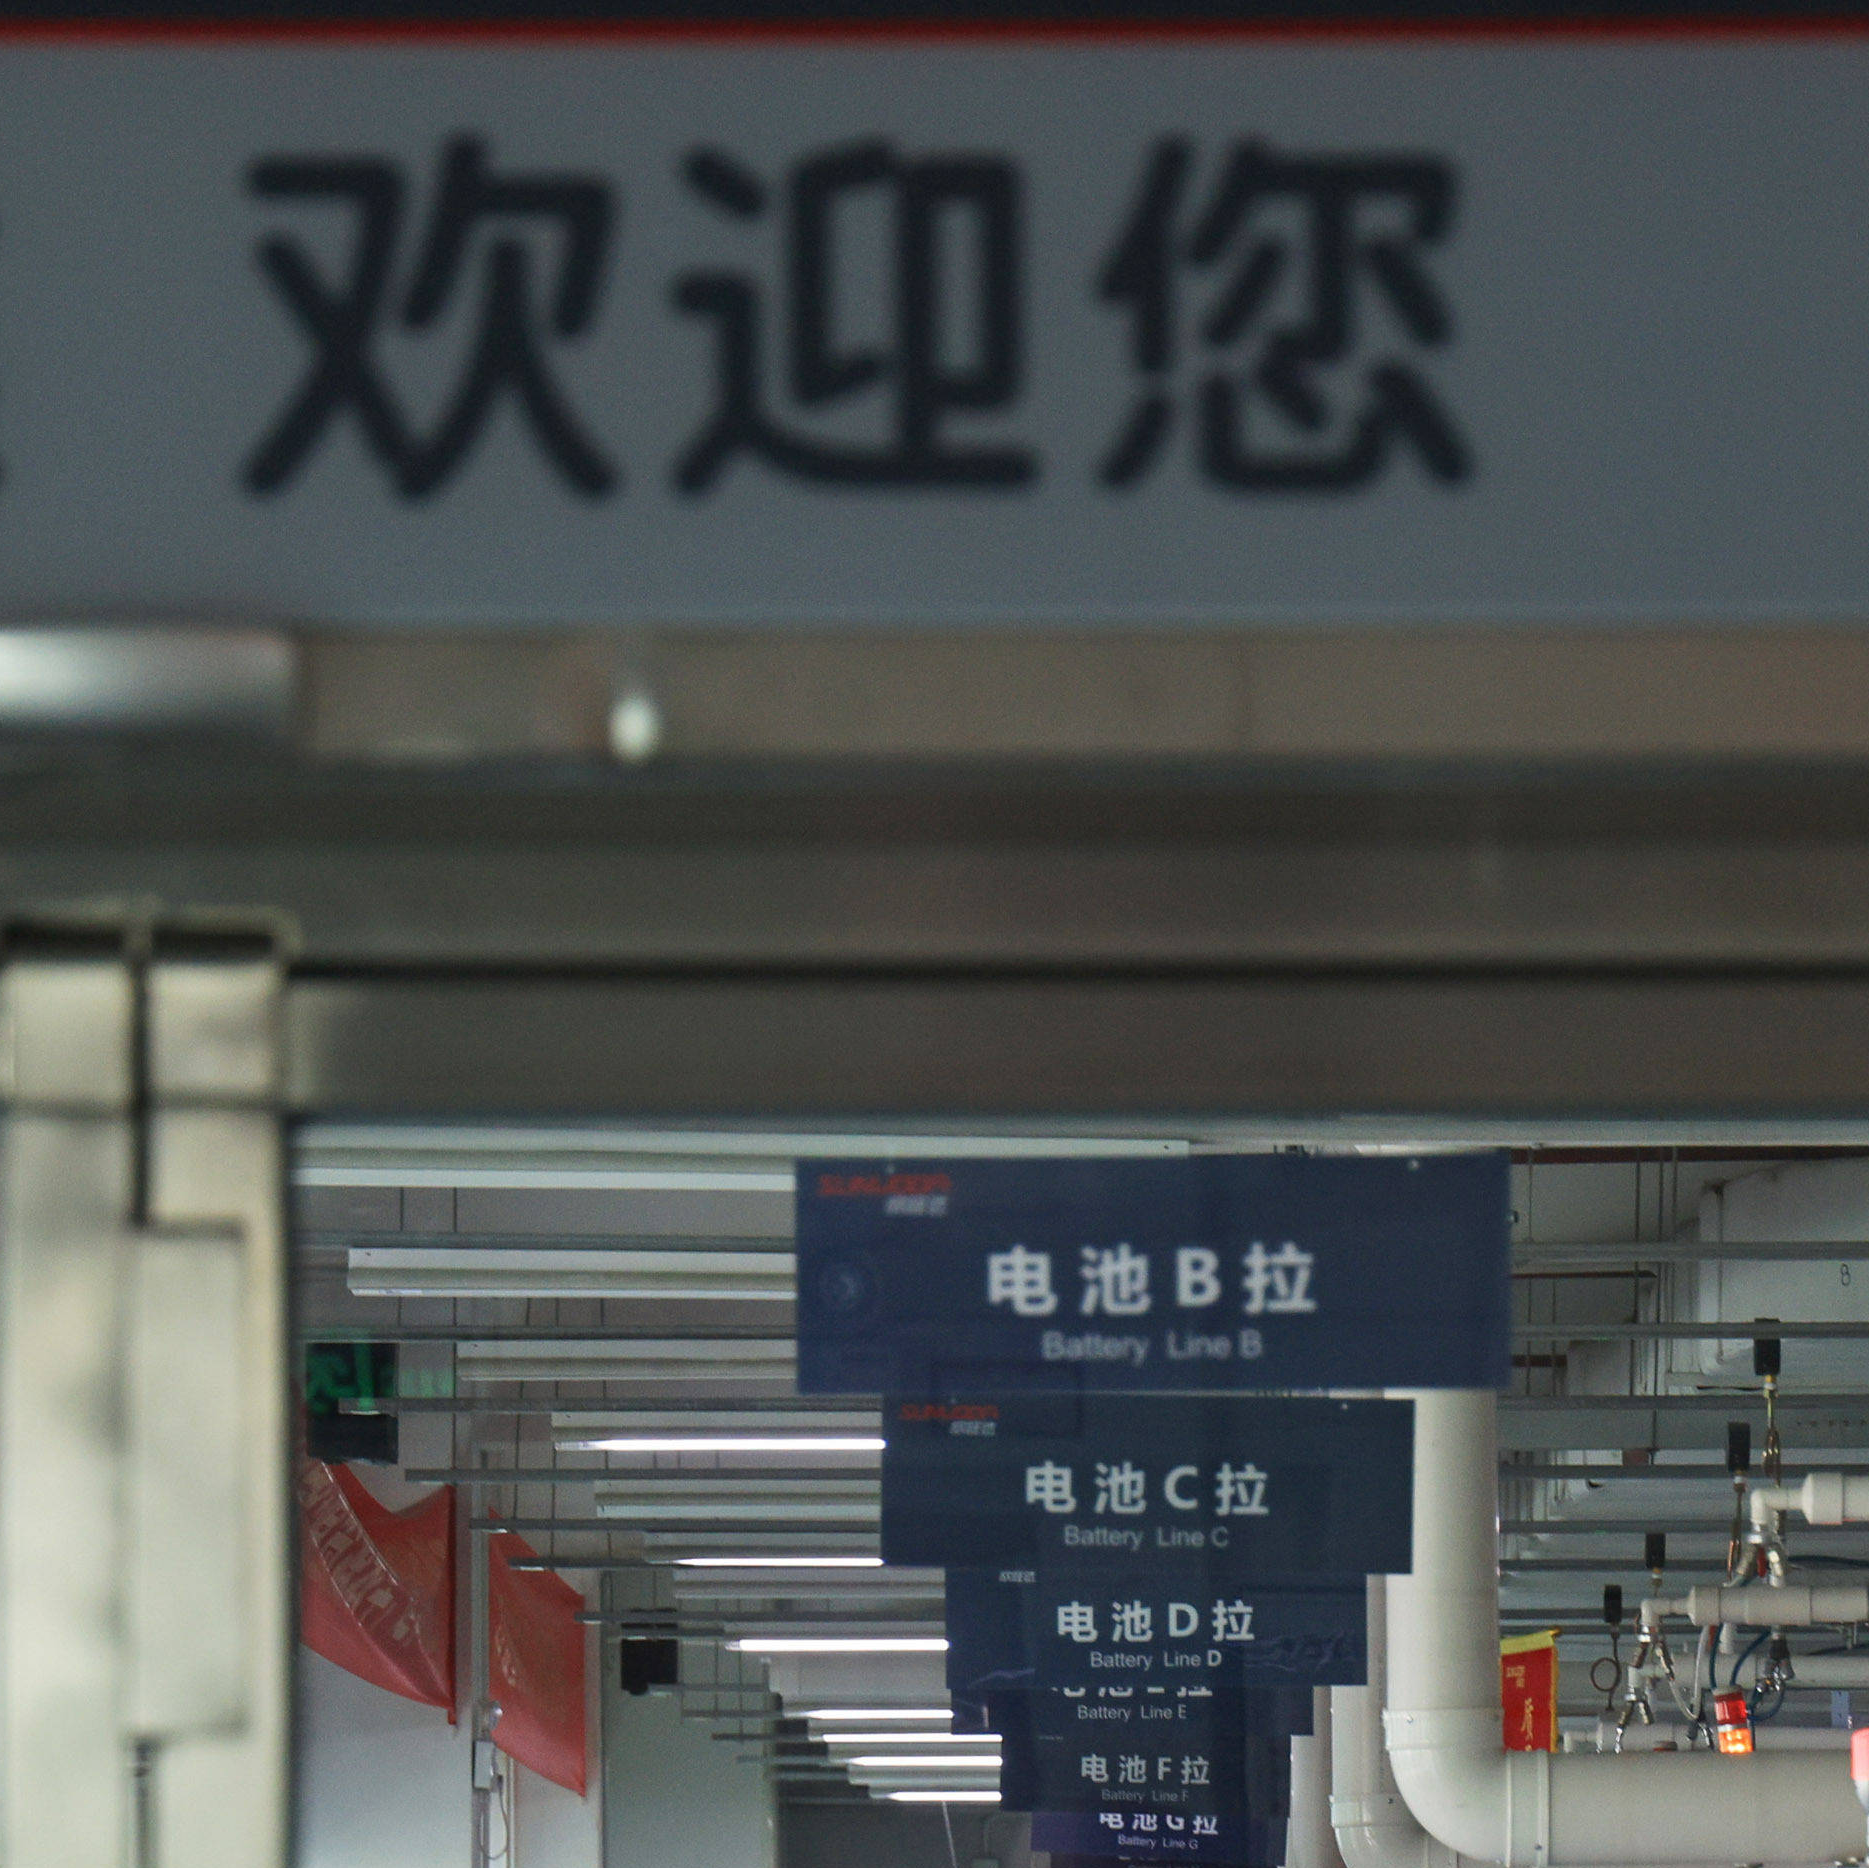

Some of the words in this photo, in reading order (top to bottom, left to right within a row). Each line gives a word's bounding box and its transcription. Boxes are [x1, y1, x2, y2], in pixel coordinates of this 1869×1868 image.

[238, 130, 1480, 500] 欢迎您
[987, 1241, 1319, 1317] 电池B拉
[1041, 1329, 1149, 1368] Battery
[1165, 1329, 1231, 1360] Line
[1239, 1328, 1262, 1360] B
[1026, 1460, 1269, 1516] 电池C拉
[1064, 1525, 1144, 1550] Battery
[1157, 1526, 1205, 1546] Line
[1211, 1526, 1229, 1547] C
[1057, 1600, 1255, 1643] 电池D拉
[1090, 1651, 1152, 1671] Battery
[1163, 1651, 1201, 1667] Line
[1207, 1650, 1222, 1667] D
[1077, 1704, 1131, 1721] Battery
[1141, 1704, 1173, 1719] Line
[1178, 1704, 1187, 1719] E
[1081, 1753, 1211, 1785] 电池F拉
[1101, 1788, 1146, 1804] Battery
[1152, 1789, 1178, 1801] Line
[1118, 1834, 1156, 1849] Battery
[1163, 1836, 1186, 1848] Line
[1189, 1838, 1199, 1849] G
